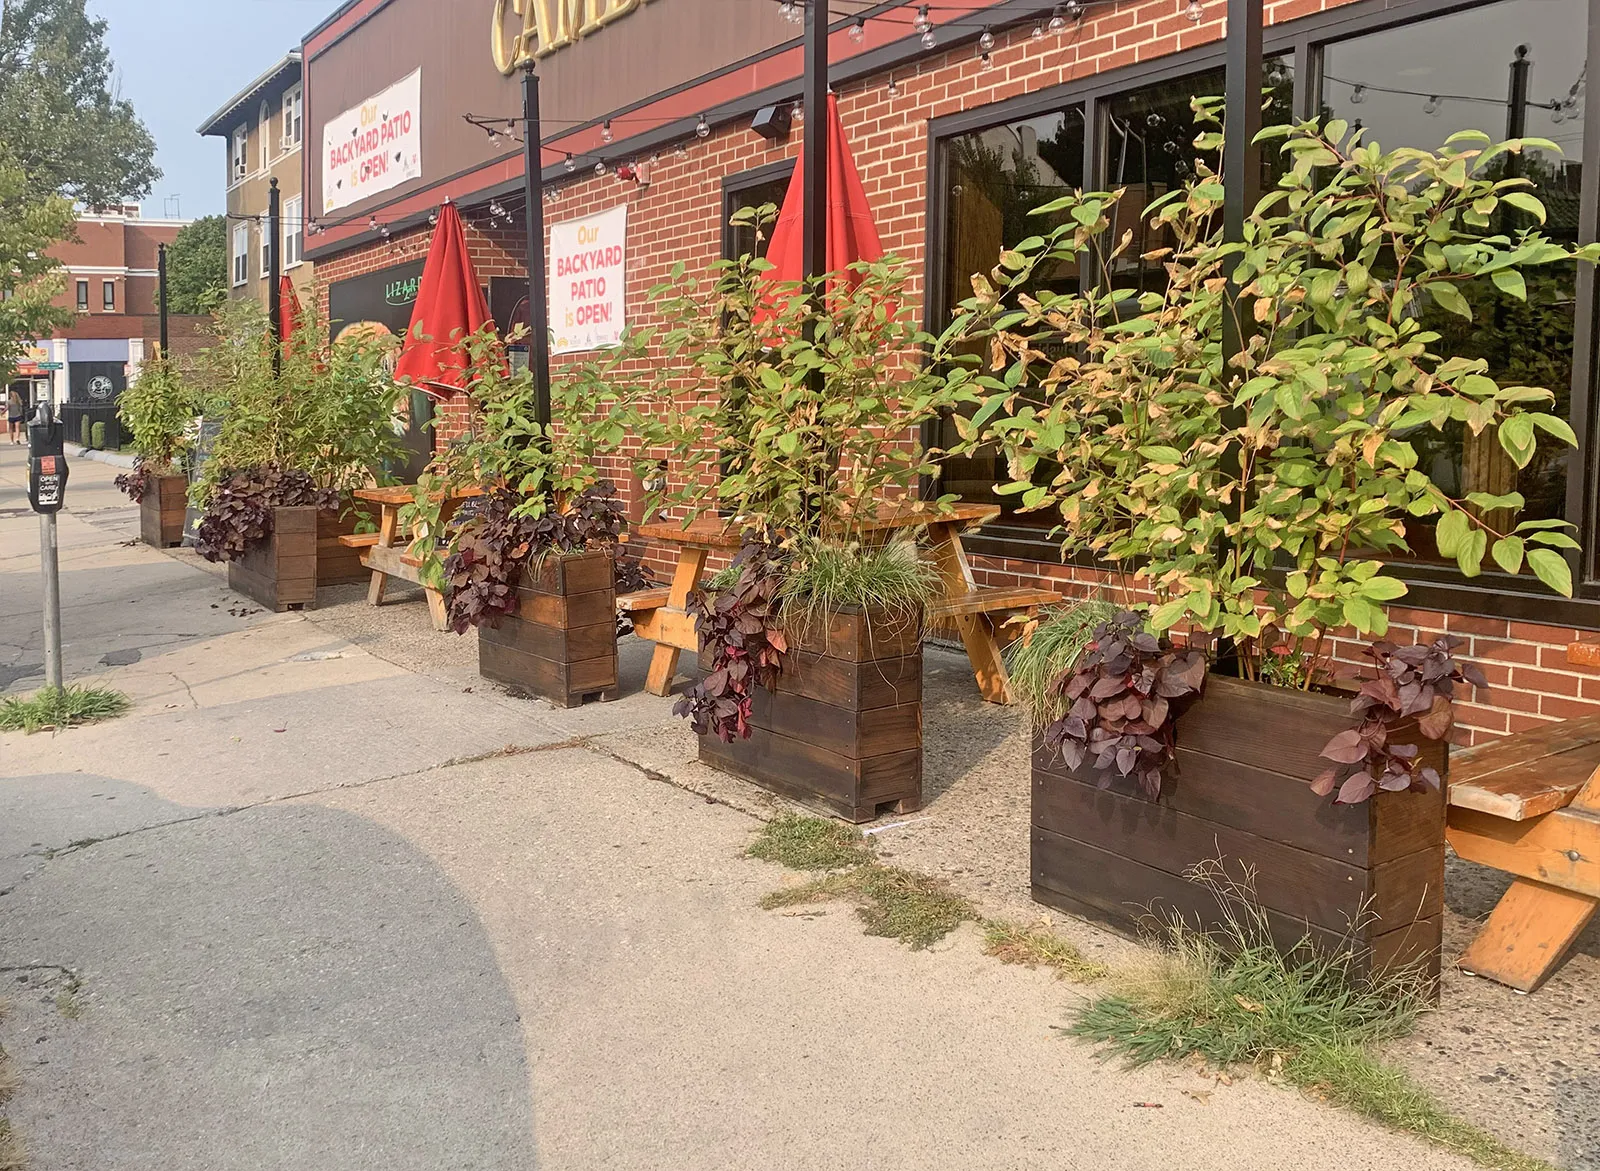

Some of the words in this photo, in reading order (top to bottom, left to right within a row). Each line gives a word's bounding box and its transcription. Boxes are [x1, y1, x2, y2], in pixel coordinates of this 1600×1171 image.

[490, 0, 658, 75] CAM
[360, 104, 377, 127] Our
[330, 128, 378, 170] BACKYARD
[381, 110, 411, 146] PATIO
[351, 165, 358, 187] is
[359, 150, 389, 183] OPEN!
[577, 225, 599, 245] Our
[557, 245, 622, 277] BACKYARD
[571, 277, 606, 301] PATIO
[565, 308, 574, 328] is
[576, 302, 612, 326] OPEN!
